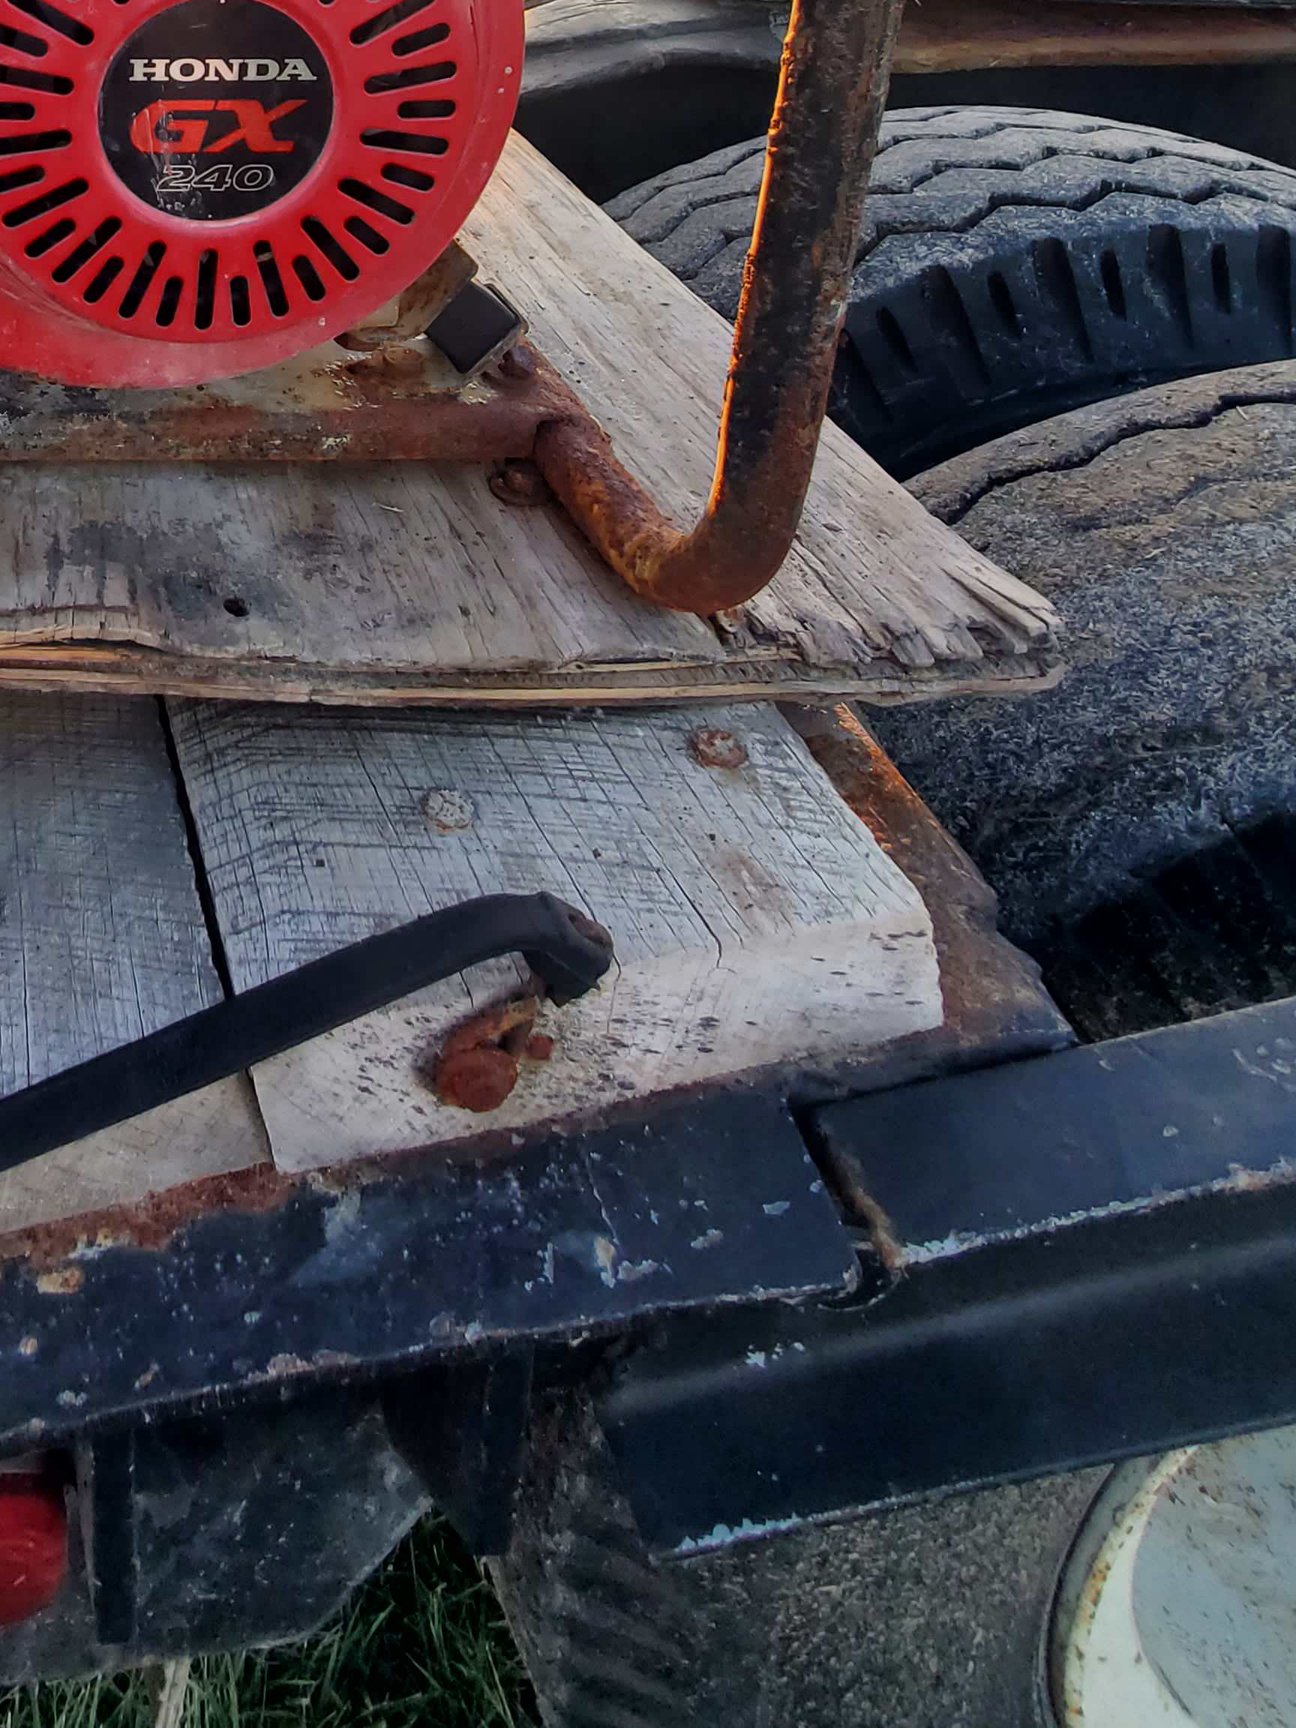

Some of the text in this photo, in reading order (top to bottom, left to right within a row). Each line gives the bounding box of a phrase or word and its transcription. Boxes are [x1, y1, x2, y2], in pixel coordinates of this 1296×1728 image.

[129, 58, 317, 82] HONDA
[128, 99, 308, 154] GX
[156, 164, 274, 192] 240
